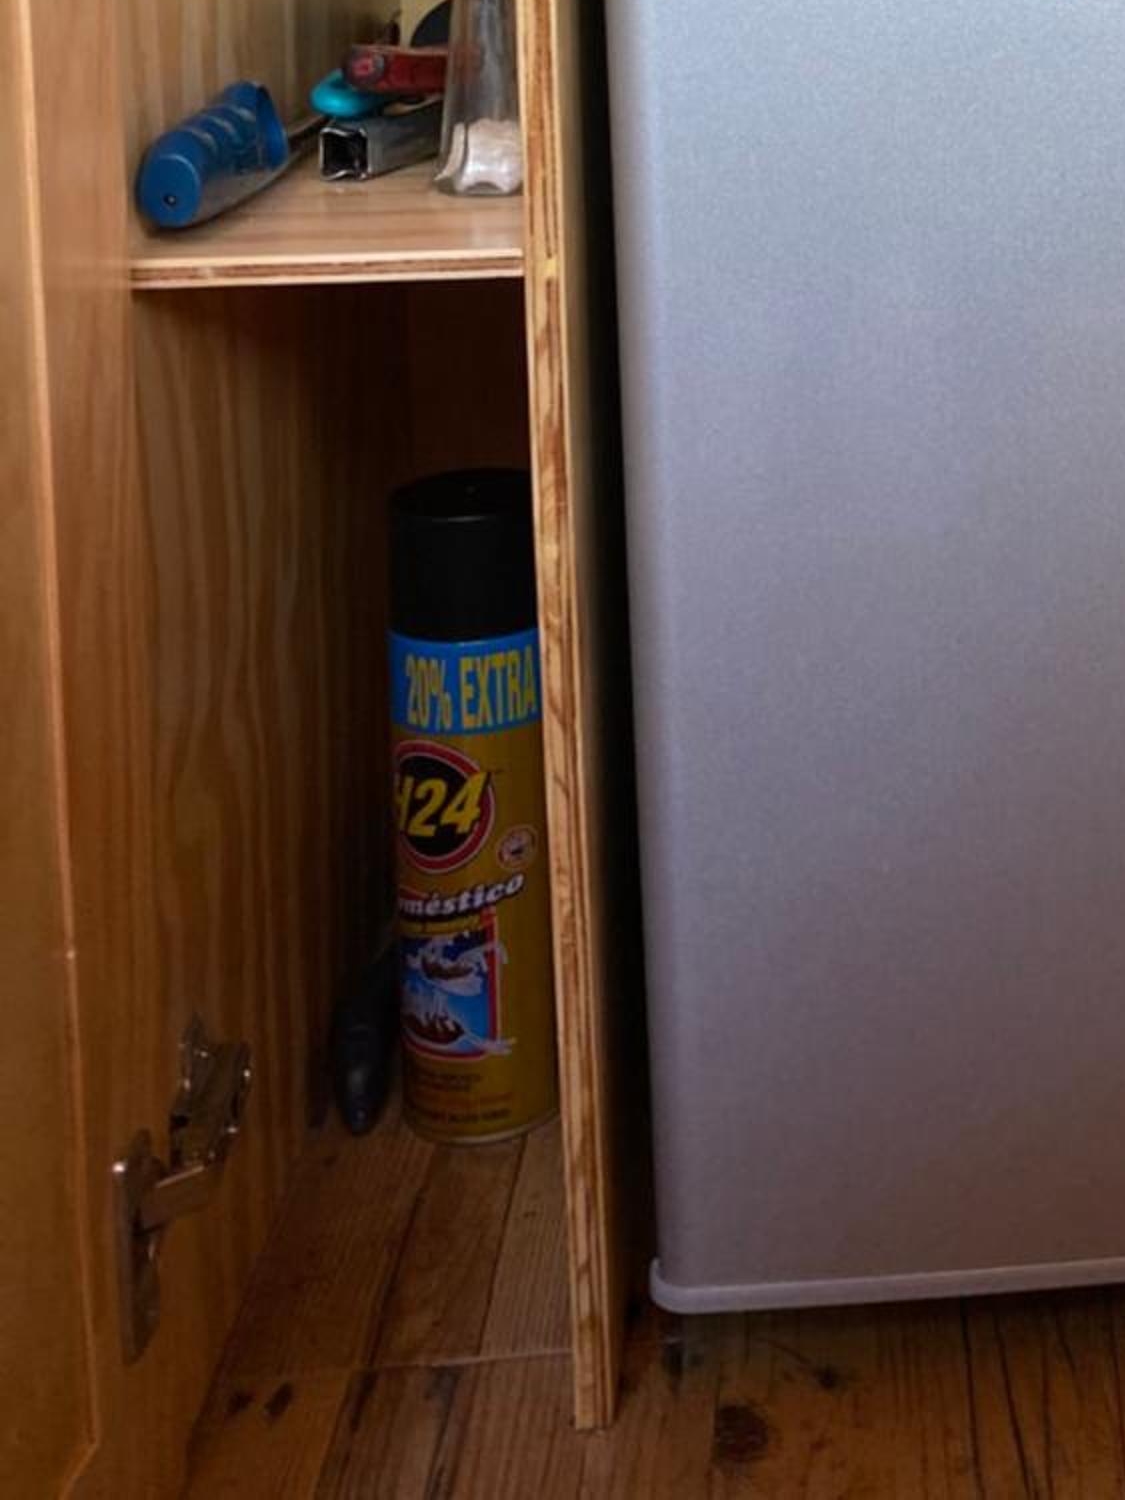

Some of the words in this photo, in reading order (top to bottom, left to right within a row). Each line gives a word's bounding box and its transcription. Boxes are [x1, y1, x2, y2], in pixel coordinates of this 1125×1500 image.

[405, 652, 452, 731] 20%
[460, 644, 537, 730] EXTRA
[399, 873, 525, 916] méstico
